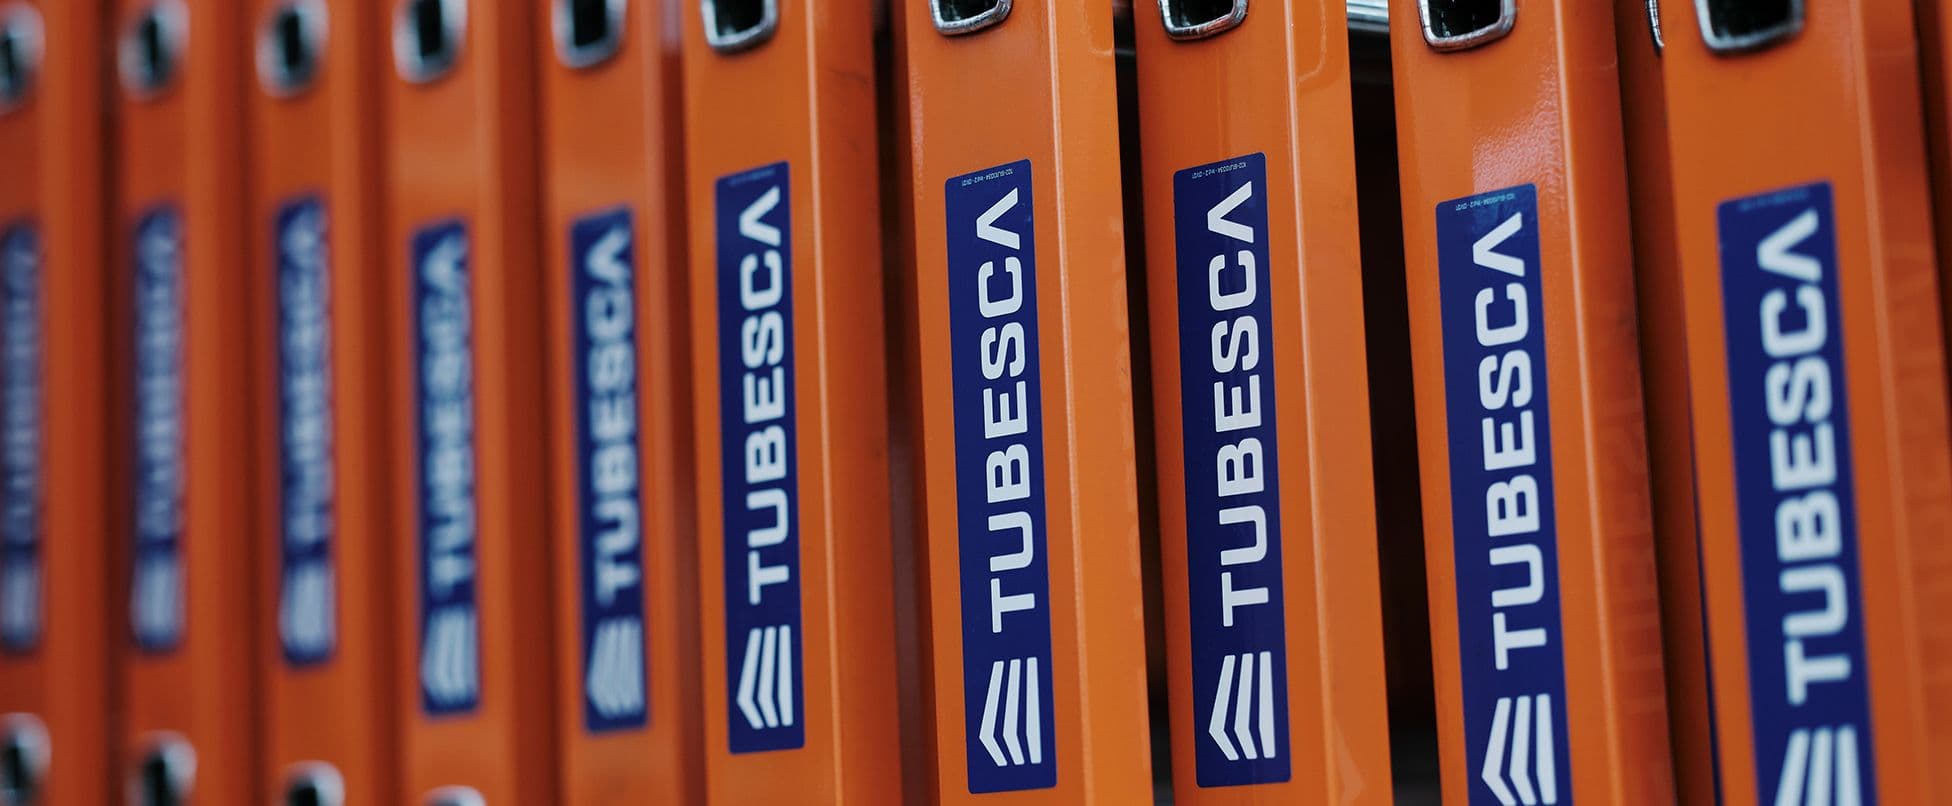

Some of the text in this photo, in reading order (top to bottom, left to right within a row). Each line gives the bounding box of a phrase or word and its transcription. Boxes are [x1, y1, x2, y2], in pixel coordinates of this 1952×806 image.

[585, 226, 640, 606] TUBESCA
[739, 184, 790, 605] TUBESCA
[975, 186, 1036, 633] TUBESCA
[1207, 180, 1269, 627] TUBESCA
[1472, 211, 1548, 670] TUBESCA
[1757, 208, 1852, 706] TUBESCA
